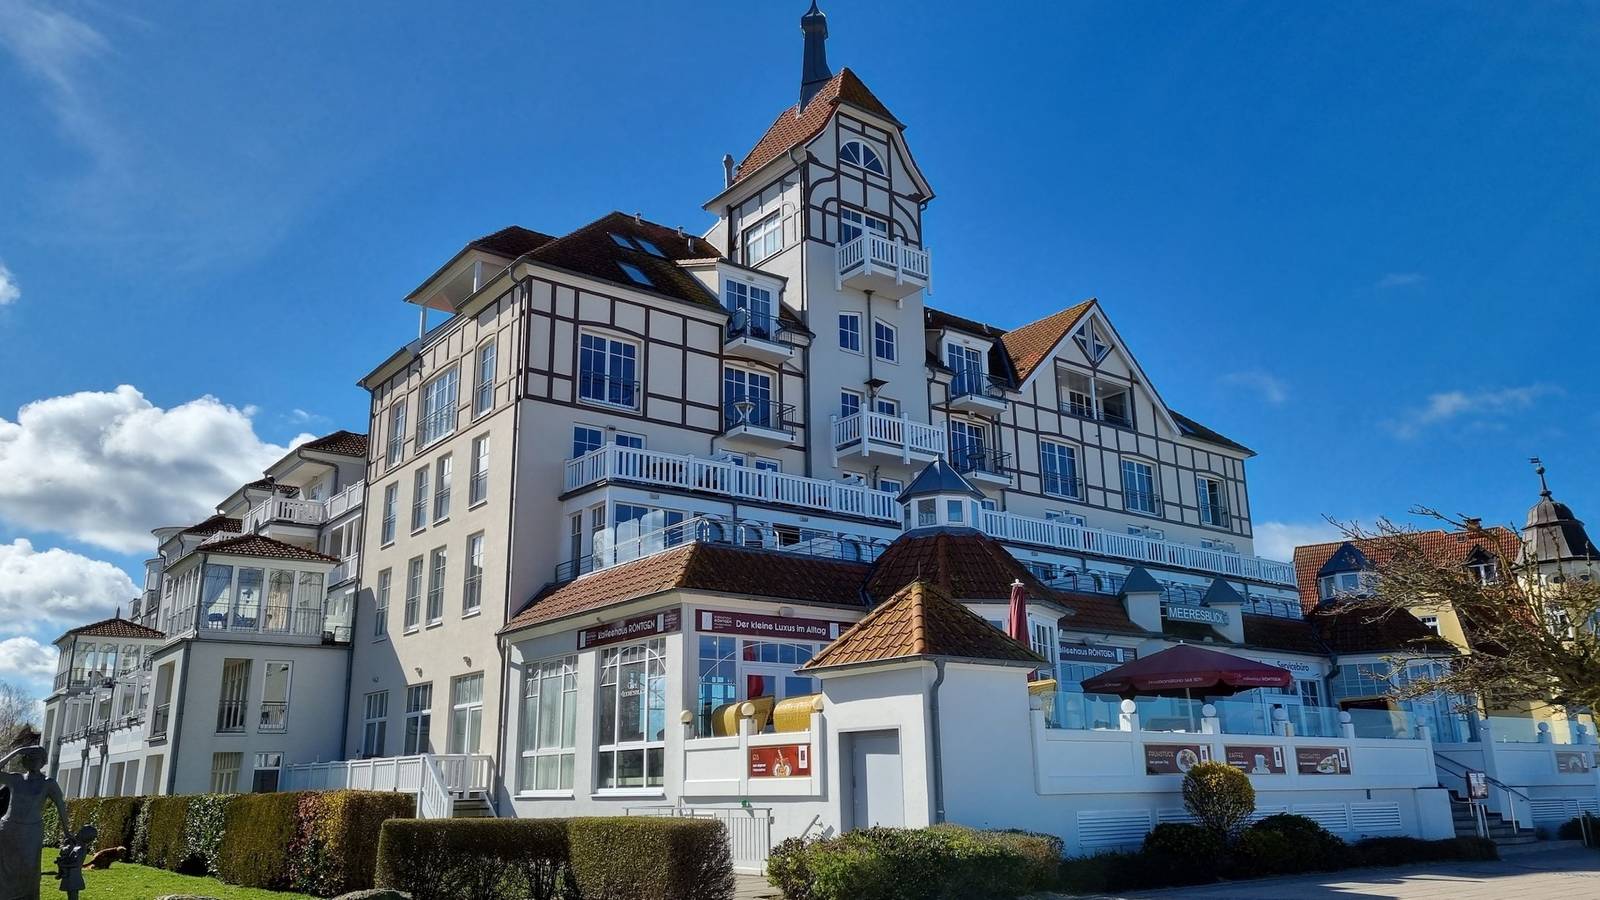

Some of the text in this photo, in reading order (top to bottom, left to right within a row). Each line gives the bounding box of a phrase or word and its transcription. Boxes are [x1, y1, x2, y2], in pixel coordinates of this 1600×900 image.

[1168, 607, 1224, 624] MEERESBLICK
[628, 619, 656, 633] RÖNTGEN
[735, 619, 827, 636] Der kleine Luxus im Alltag
[1088, 647, 1116, 658] RÖNTGEN
